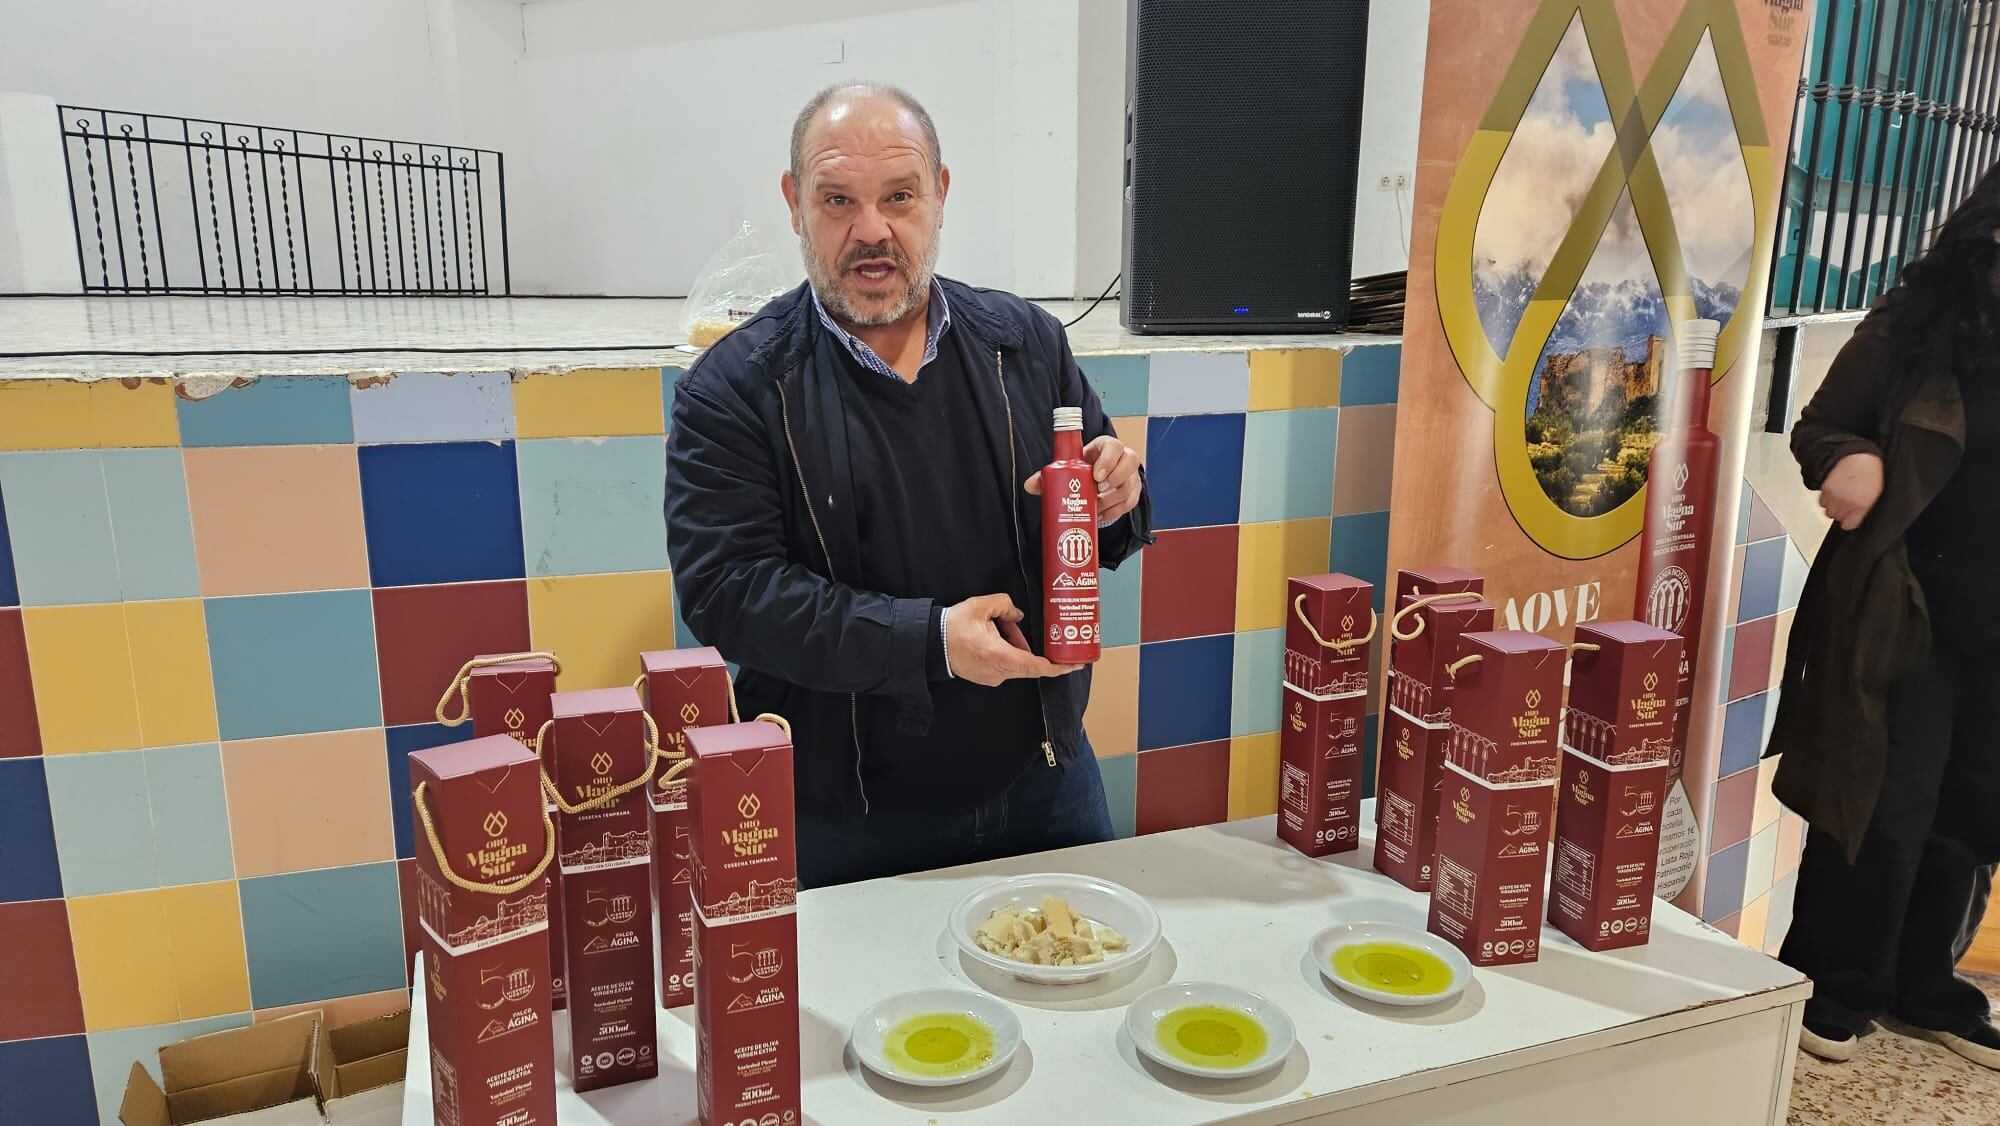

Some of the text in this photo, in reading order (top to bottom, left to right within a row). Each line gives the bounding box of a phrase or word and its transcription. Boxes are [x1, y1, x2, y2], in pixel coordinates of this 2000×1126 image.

[1663, 503, 1694, 522] Magna
[1665, 519, 1686, 532] Sur
[1498, 582, 1600, 633] AOVE
[1631, 697, 1666, 711] Magna
[1636, 709, 1658, 720] Sur
[1512, 716, 1550, 730] Magna
[1518, 728, 1541, 738] Sur
[593, 777, 612, 785] ORO
[1669, 796, 1681, 805] Por
[1666, 807, 1682, 818] cada
[739, 820, 760, 829] ORO
[722, 825, 779, 846] Magna
[486, 838, 508, 849] ORO
[734, 841, 767, 858] Sur
[466, 843, 528, 868] Magna
[724, 856, 778, 869] COSECHA TEMPRANA
[1661, 850, 1694, 867] Lista Roja
[480, 861, 516, 879] Sur
[591, 984, 609, 992] ACEITE
[599, 1024, 629, 1035] 500ml
[734, 1045, 754, 1055] ACEITE
[762, 1040, 779, 1048] OLIVA
[736, 1047, 777, 1059] VIRGEN EXTRA
[486, 1071, 507, 1084] ACEITE
[516, 1062, 534, 1073] OLIVA
[490, 1070, 531, 1088] VIRGEN EXTRA
[742, 1087, 773, 1101] 500ml
